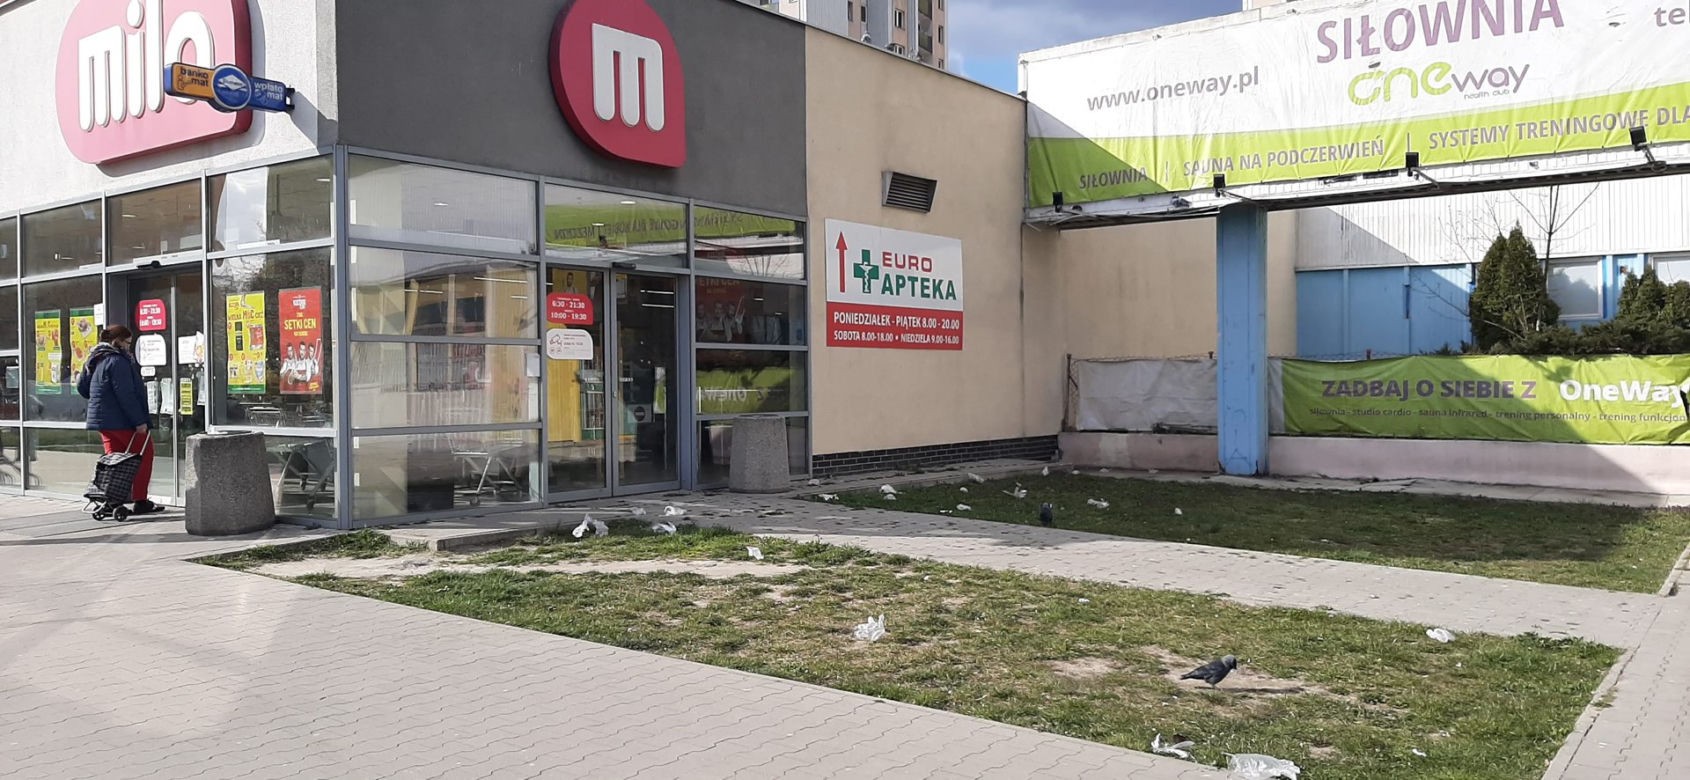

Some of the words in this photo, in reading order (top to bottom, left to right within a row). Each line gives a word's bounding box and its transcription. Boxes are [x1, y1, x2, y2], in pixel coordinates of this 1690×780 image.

[1654, 1, 1690, 27] te
[1317, 0, 1564, 64] SIŁOWNIA
[180, 66, 209, 79] banko
[191, 77, 209, 87] mat
[267, 91, 283, 101] mat
[1087, 65, 1259, 111] www.oneway.pl
[1429, 125, 1509, 149] SYSTEMY
[1516, 110, 1649, 139] TRENINGOWE
[1184, 156, 1234, 177] SAUNA
[1240, 153, 1261, 170] NA
[1267, 135, 1384, 168] PODCZERWIEŃ
[1079, 167, 1148, 190] SIŁOWNIA
[882, 251, 933, 273] EURO
[881, 273, 957, 301] APTEKA
[284, 319, 302, 330] SETKI
[303, 318, 316, 329] CEN
[833, 311, 891, 326] PONIEDZIAŁEK
[896, 316, 921, 330] PIĄTEK
[922, 317, 937, 329] 8.00
[942, 318, 960, 330] 20.00
[834, 330, 860, 341] SOBOTA
[900, 333, 931, 344] NIEDZIELA
[1321, 379, 1409, 402] ZADBAJ
[1416, 379, 1434, 398] O
[1440, 380, 1514, 399] SIEBIE
[1521, 381, 1537, 399] Z
[1559, 379, 1688, 408] OneWay
[1352, 407, 1380, 417] studio
[1383, 408, 1411, 417] cardio
[1419, 409, 1447, 417] sauna
[1449, 408, 1487, 418] infrared
[1495, 411, 1532, 421] trening
[1534, 411, 1590, 422] personalny
[1600, 413, 1637, 423] trening
